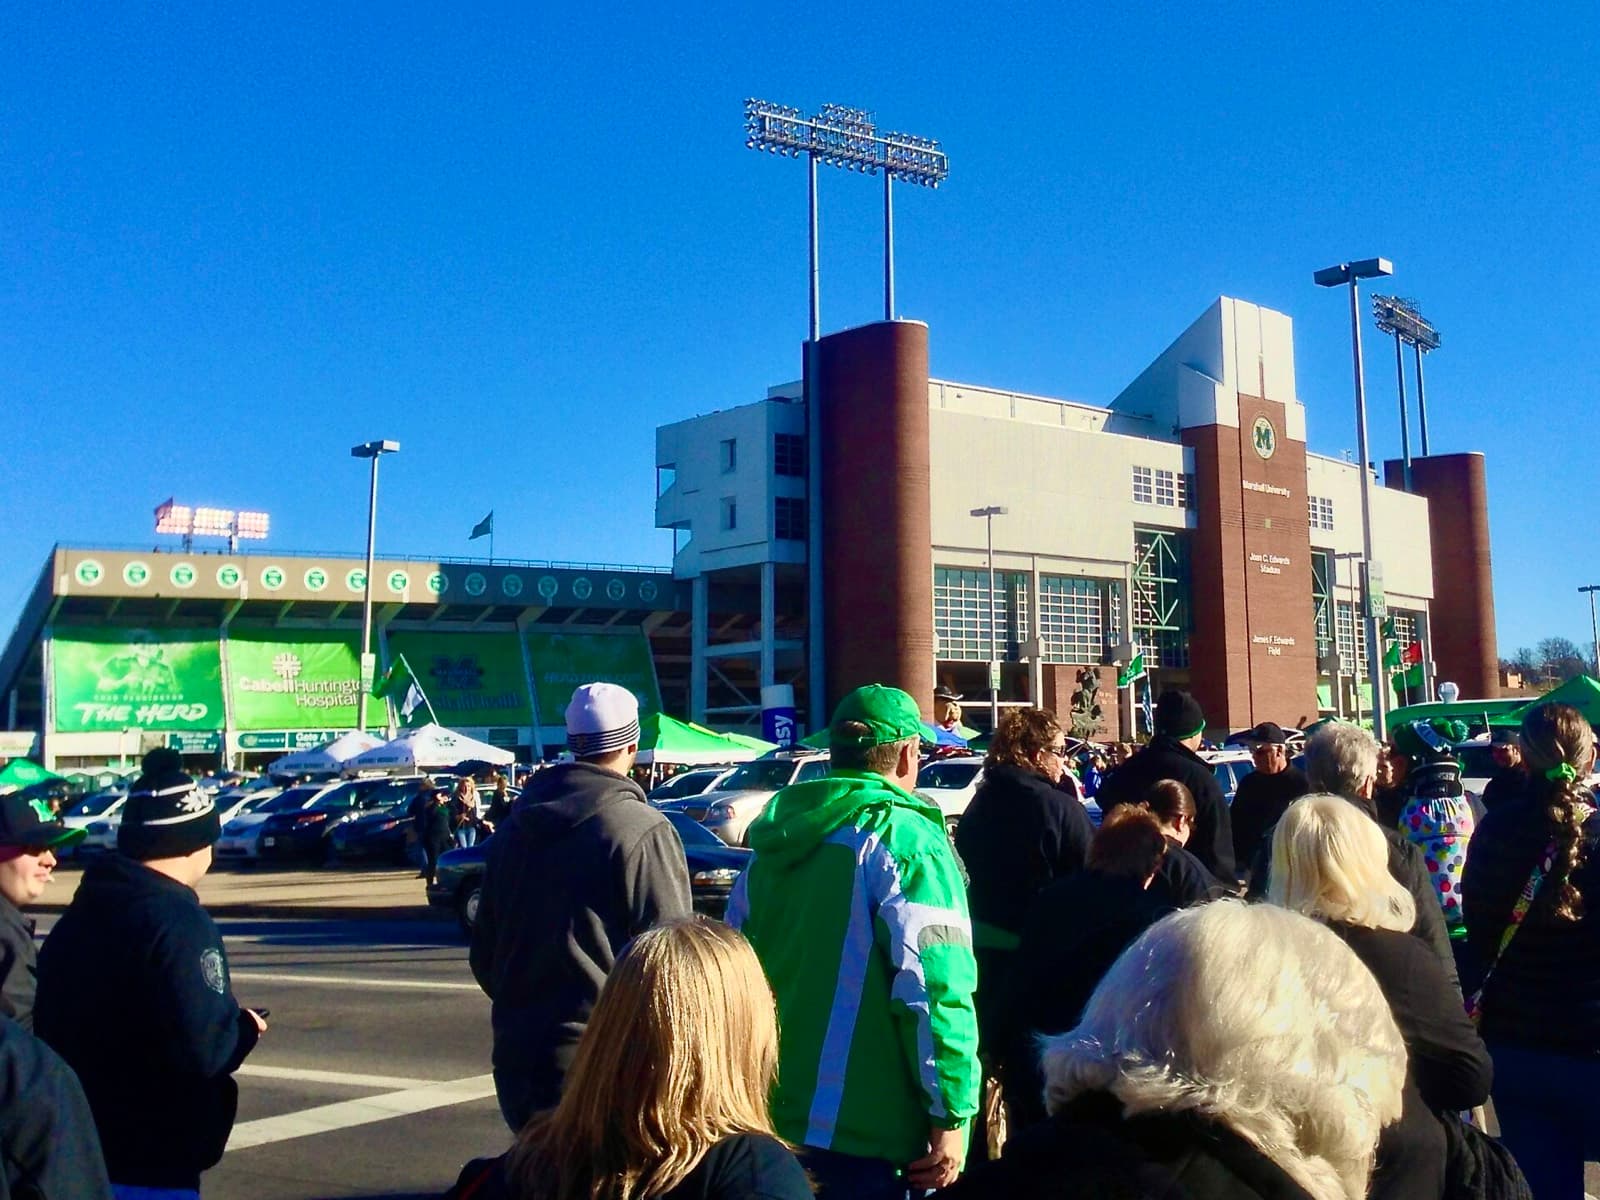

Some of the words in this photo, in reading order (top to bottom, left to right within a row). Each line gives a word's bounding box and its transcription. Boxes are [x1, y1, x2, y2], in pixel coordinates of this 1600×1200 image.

[296, 692, 358, 709] Hospital
[73, 702, 132, 725] THE
[135, 703, 208, 725] HERD
[295, 732, 319, 742] Gate
[319, 731, 328, 742] A
